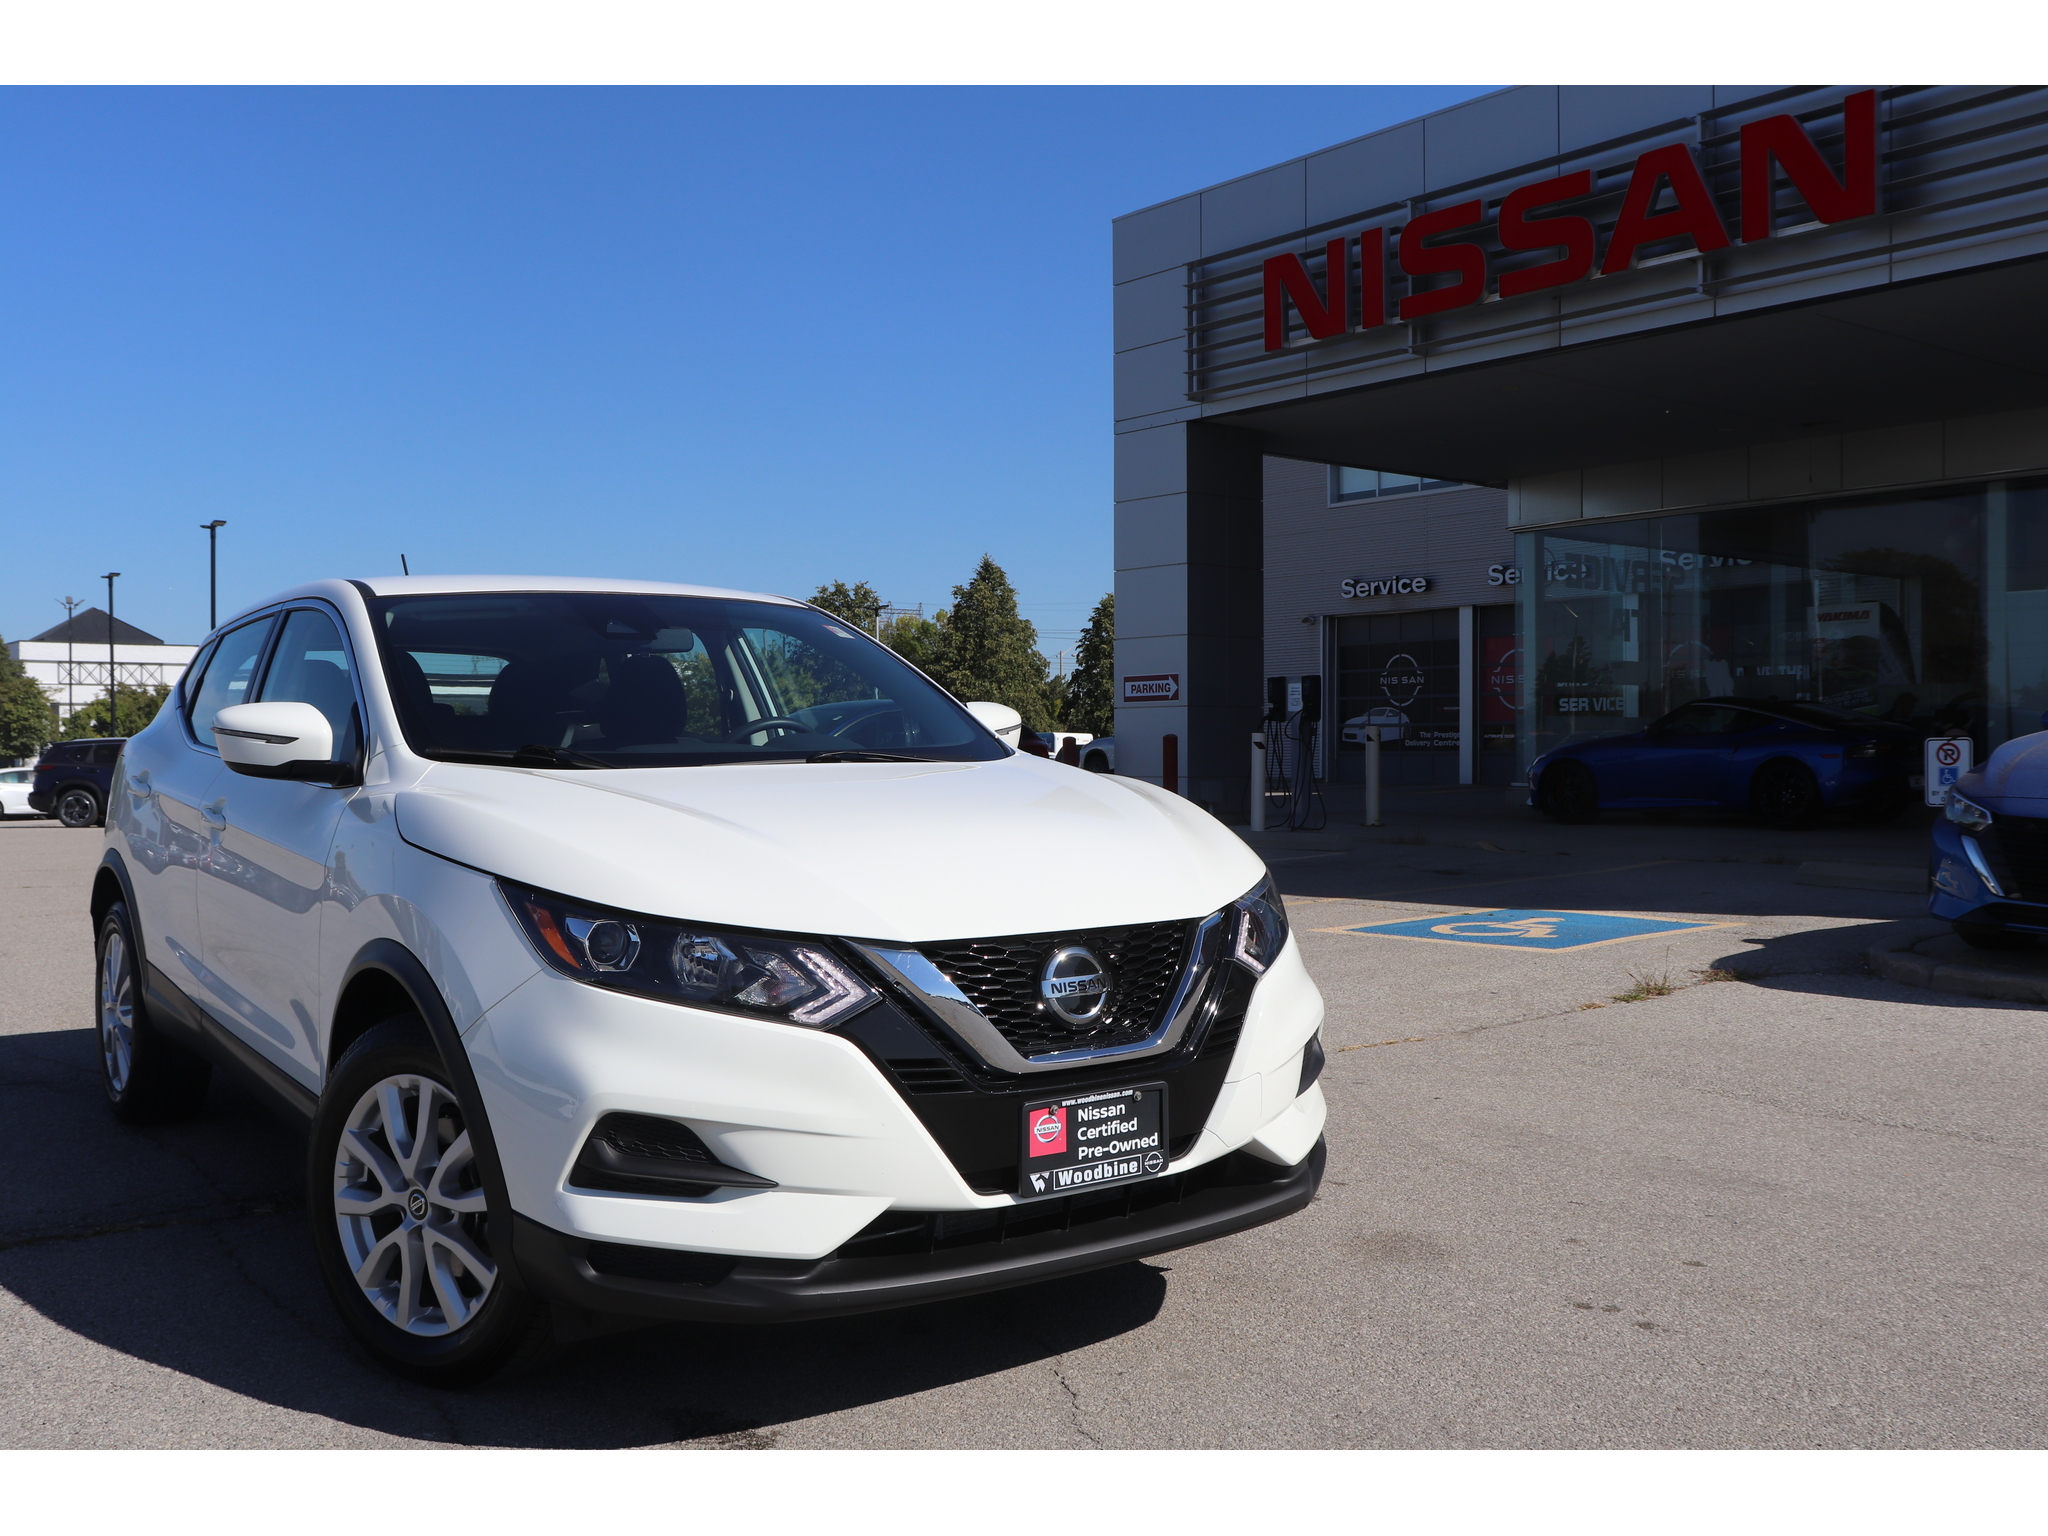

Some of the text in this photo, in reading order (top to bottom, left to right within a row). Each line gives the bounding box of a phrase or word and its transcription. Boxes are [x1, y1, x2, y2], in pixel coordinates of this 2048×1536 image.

[1263, 88, 1877, 352] NISSAN
[1340, 575, 1429, 599] Service
[1817, 610, 1871, 622] YAKIMA
[1131, 682, 1171, 694] PARKING
[1379, 675, 1425, 685] NISSAN
[1558, 697, 1624, 712] SERVICE
[1405, 739, 1431, 747] Delivery
[1050, 977, 1107, 994] NISSAN
[1061, 1089, 1134, 1107] www.woodbinenissan.com
[1077, 1103, 1126, 1123] Nissan
[1036, 1123, 1060, 1133] NISSAN
[1077, 1117, 1138, 1141] Certified
[1078, 1132, 1158, 1160] Pre-Owned
[1144, 1157, 1164, 1166] NISSAN
[1058, 1159, 1138, 1187] Woodbine
